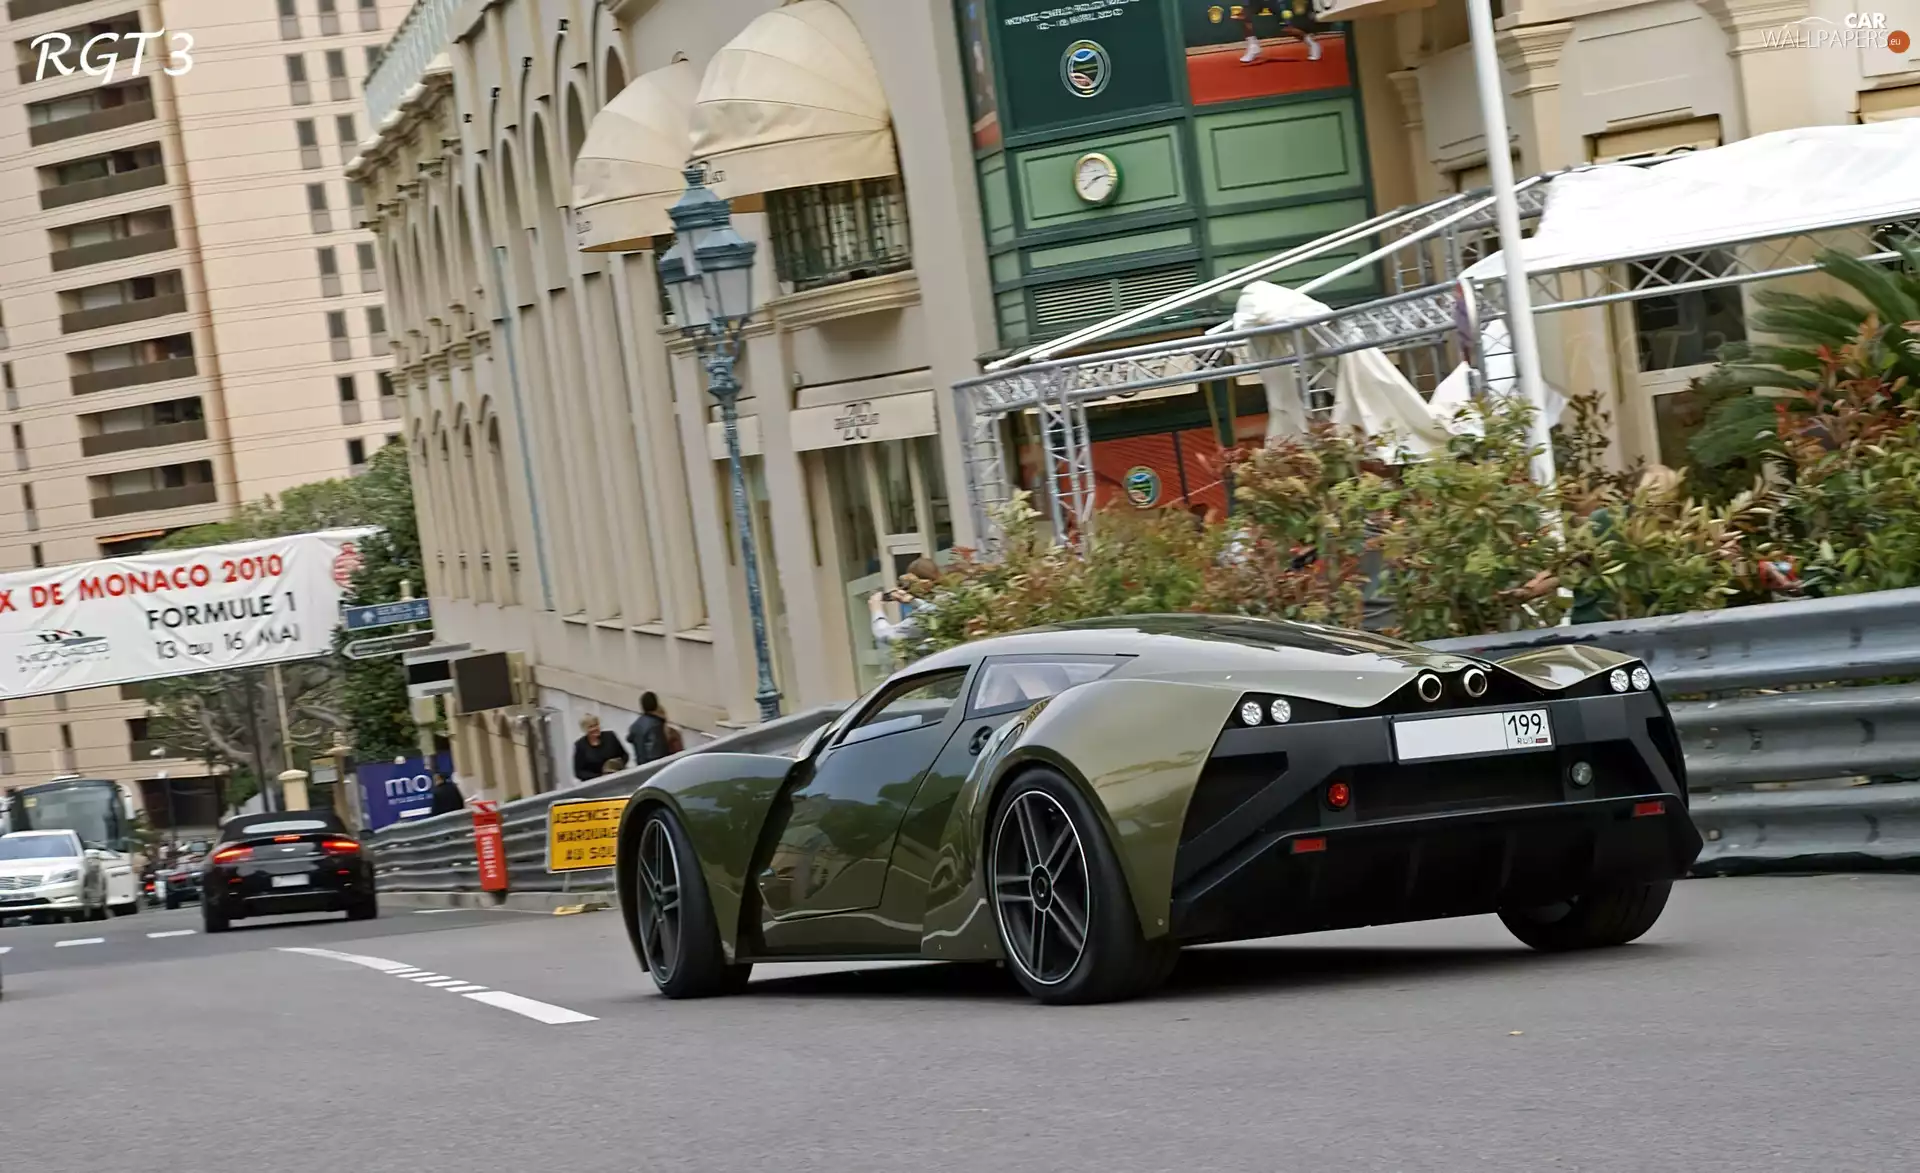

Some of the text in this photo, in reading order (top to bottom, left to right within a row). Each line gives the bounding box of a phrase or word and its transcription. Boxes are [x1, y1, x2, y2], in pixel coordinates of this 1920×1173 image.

[31, 582, 65, 608] DE
[79, 563, 210, 602] MONACO
[221, 553, 284, 584] 2010
[147, 591, 297, 630] FORMULE 1
[155, 639, 177, 660] 13
[187, 642, 214, 656] au
[223, 631, 244, 651] 16
[1508, 713, 1541, 736] 199
